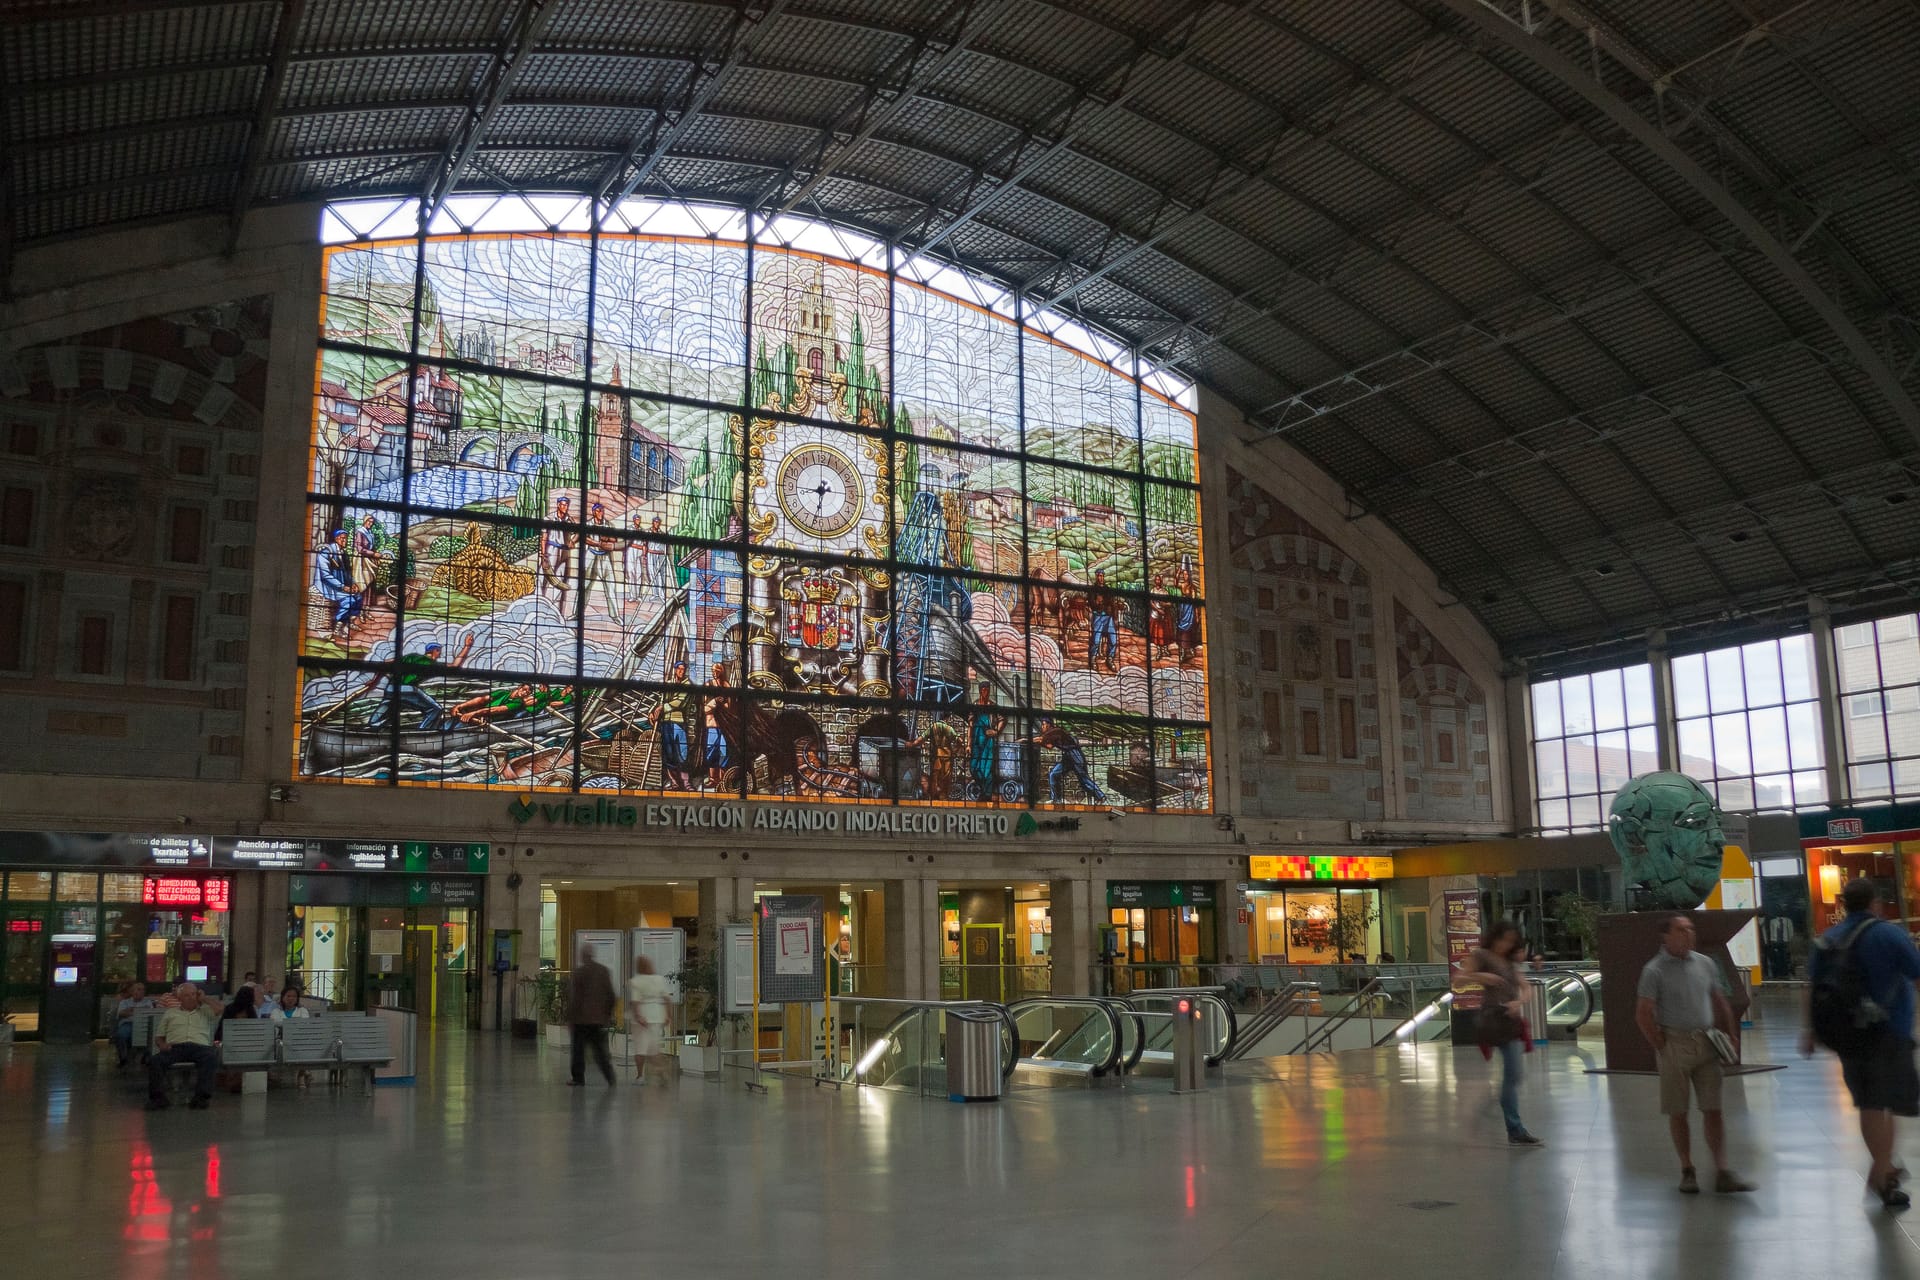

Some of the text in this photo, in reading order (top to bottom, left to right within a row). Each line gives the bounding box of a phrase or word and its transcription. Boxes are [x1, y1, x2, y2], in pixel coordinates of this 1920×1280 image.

[802, 457, 809, 466] 11
[816, 454, 827, 463] 12
[790, 468, 799, 478] 10
[844, 474, 851, 483] 2
[788, 481, 794, 490] 9
[848, 490, 854, 500] 3
[792, 499, 798, 508] 8
[844, 506, 851, 515] 4
[833, 515, 840, 525] 5
[544, 797, 637, 825] vialia
[646, 802, 1009, 834] ESTACIÓN ABANDO INDALECIO PRIETO
[1829, 823, 1844, 834] Café
[1851, 820, 1860, 833] Té
[150, 838, 160, 846] de
[161, 838, 189, 847] billetes
[237, 840, 304, 850] Atención al cliente
[347, 844, 386, 852] Información
[159, 879, 197, 887] INMEDIATA
[157, 887, 201, 895] ANTICIPADA
[158, 893, 201, 902] TELEFONICA
